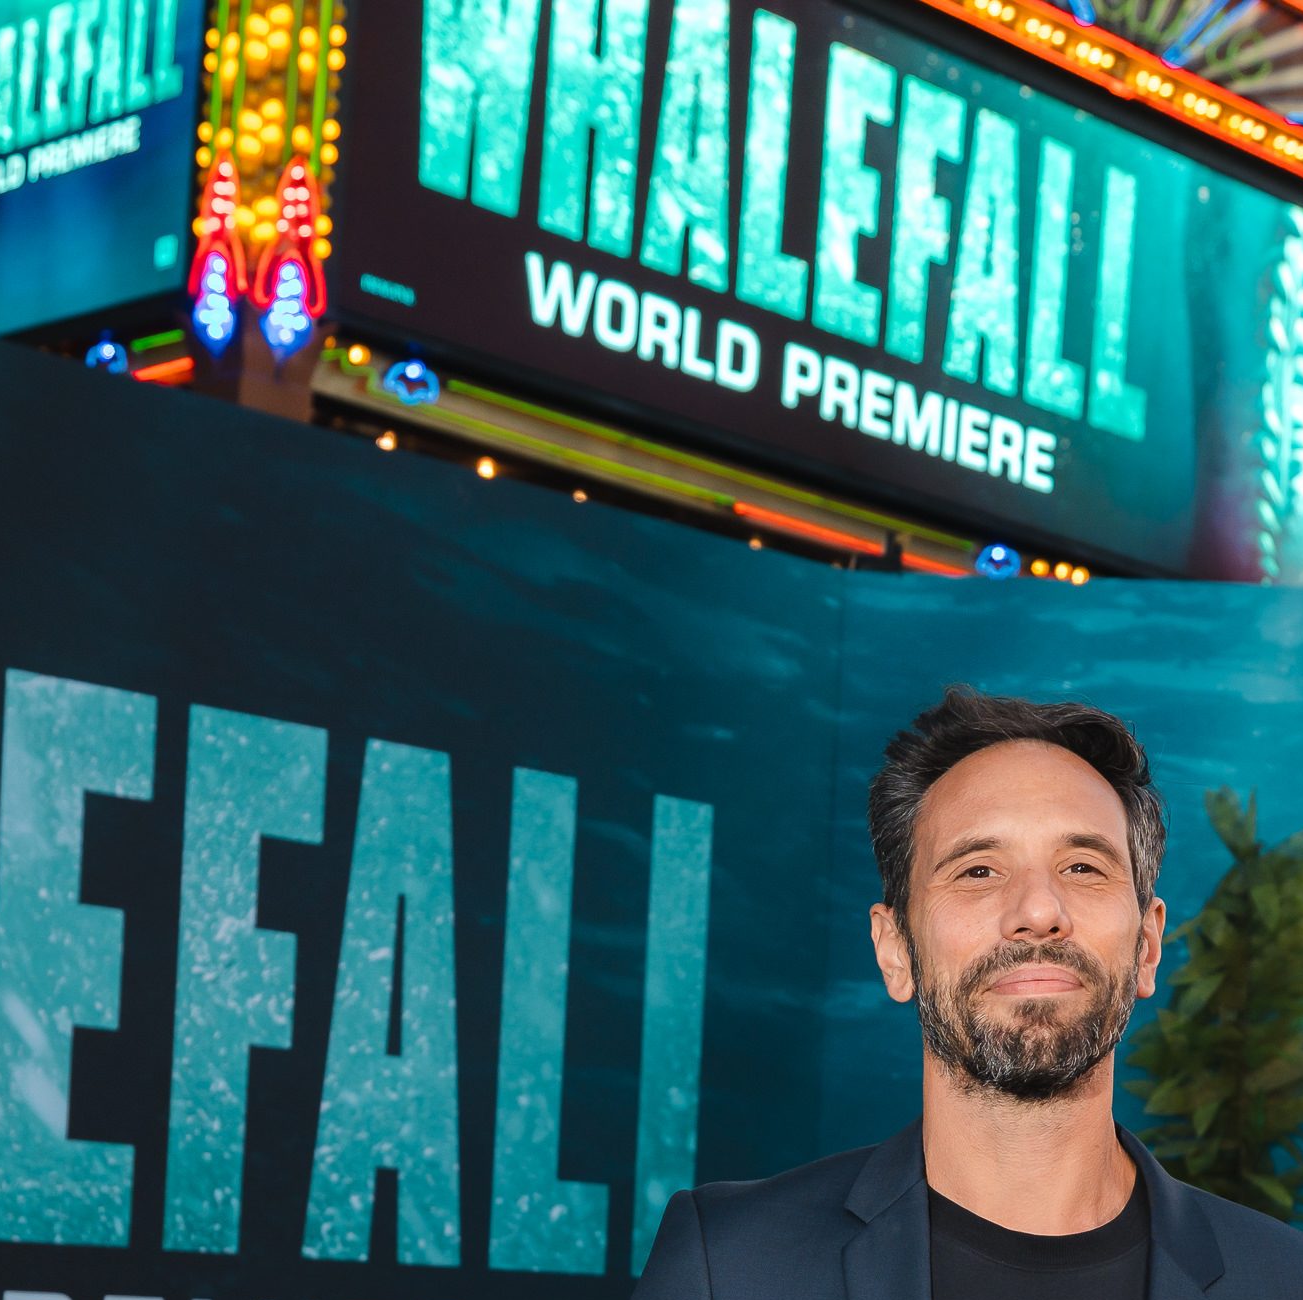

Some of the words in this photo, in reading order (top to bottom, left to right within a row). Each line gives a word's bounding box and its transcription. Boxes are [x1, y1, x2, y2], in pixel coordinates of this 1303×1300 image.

[27, 114, 142, 183] PREMIERE
[418, 0, 1148, 441] WHALEFALL
[525, 251, 761, 393] WORLD
[780, 341, 1058, 495] PREMIERE
